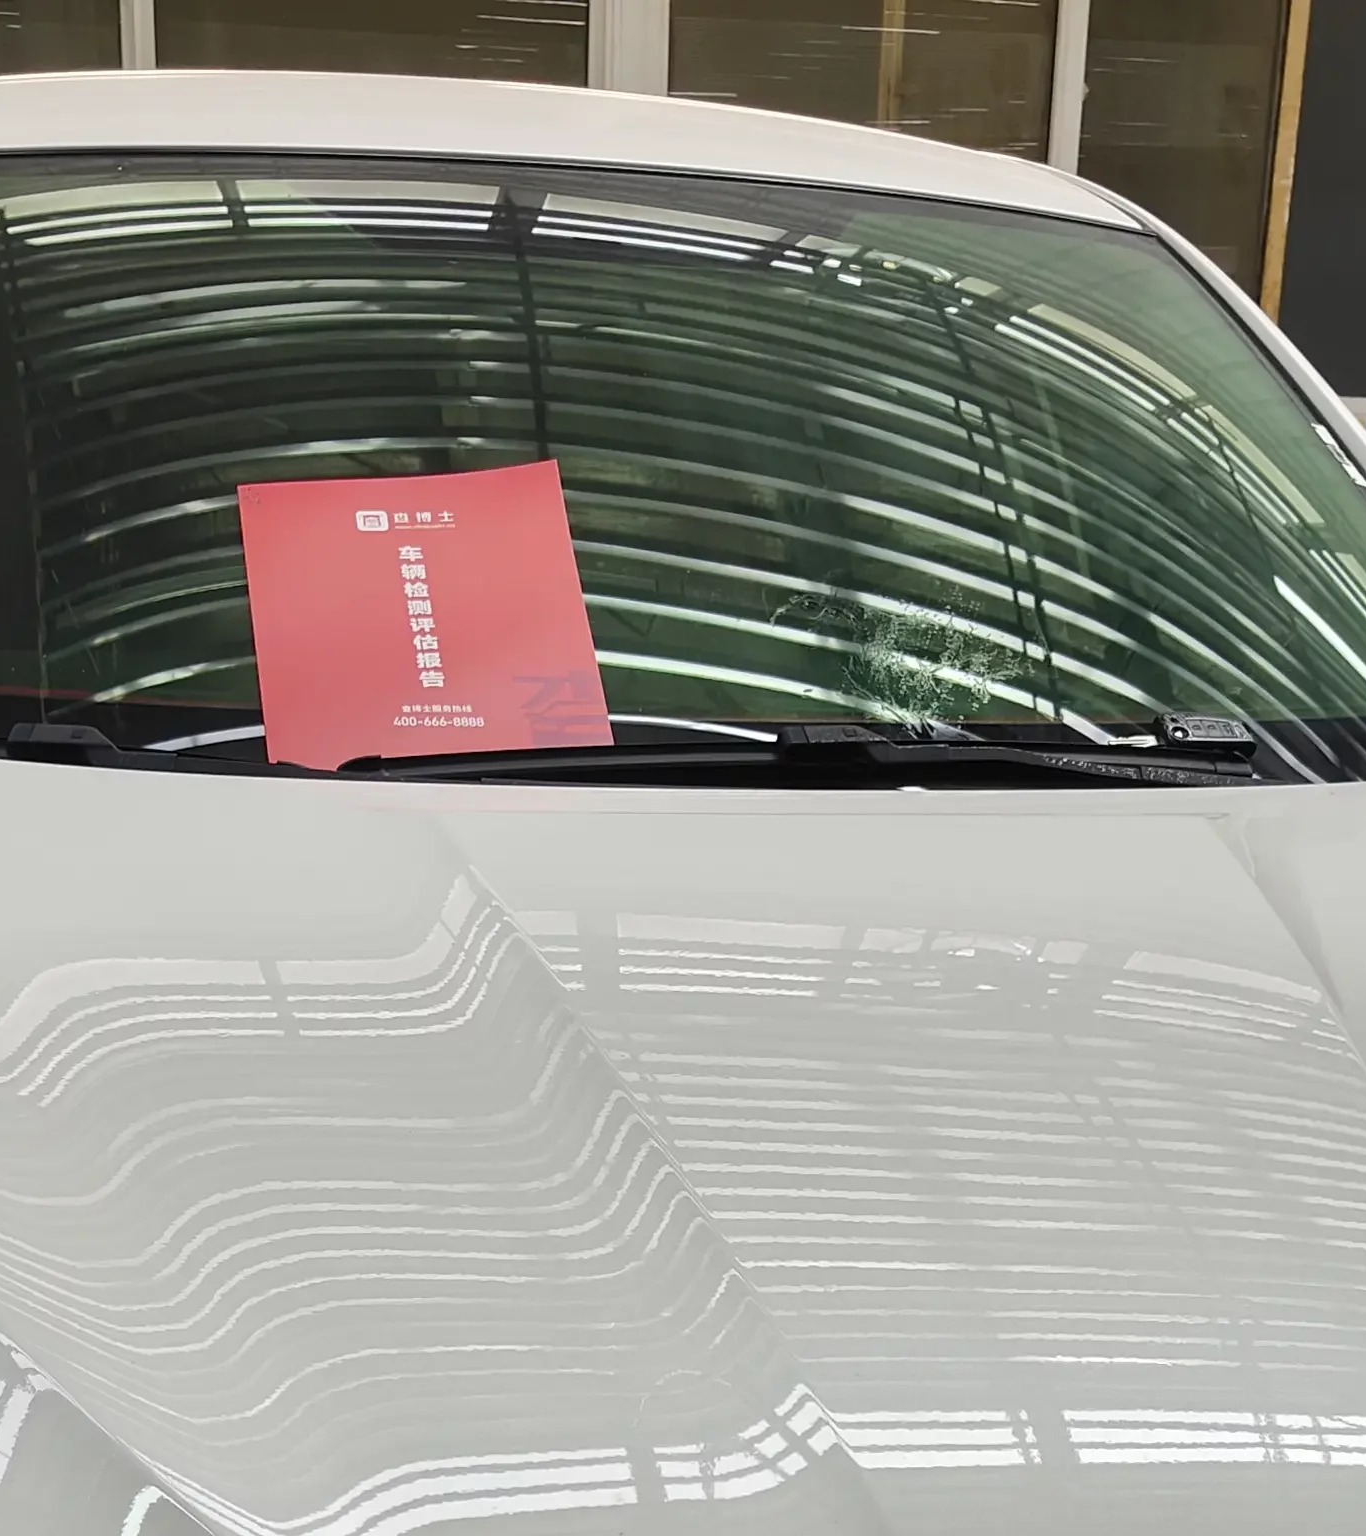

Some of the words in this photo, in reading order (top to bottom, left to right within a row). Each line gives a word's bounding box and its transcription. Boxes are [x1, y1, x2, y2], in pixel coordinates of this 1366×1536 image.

[398, 545, 445, 688] 车辆检测评估报告
[393, 716, 485, 728] 400-666-8888
